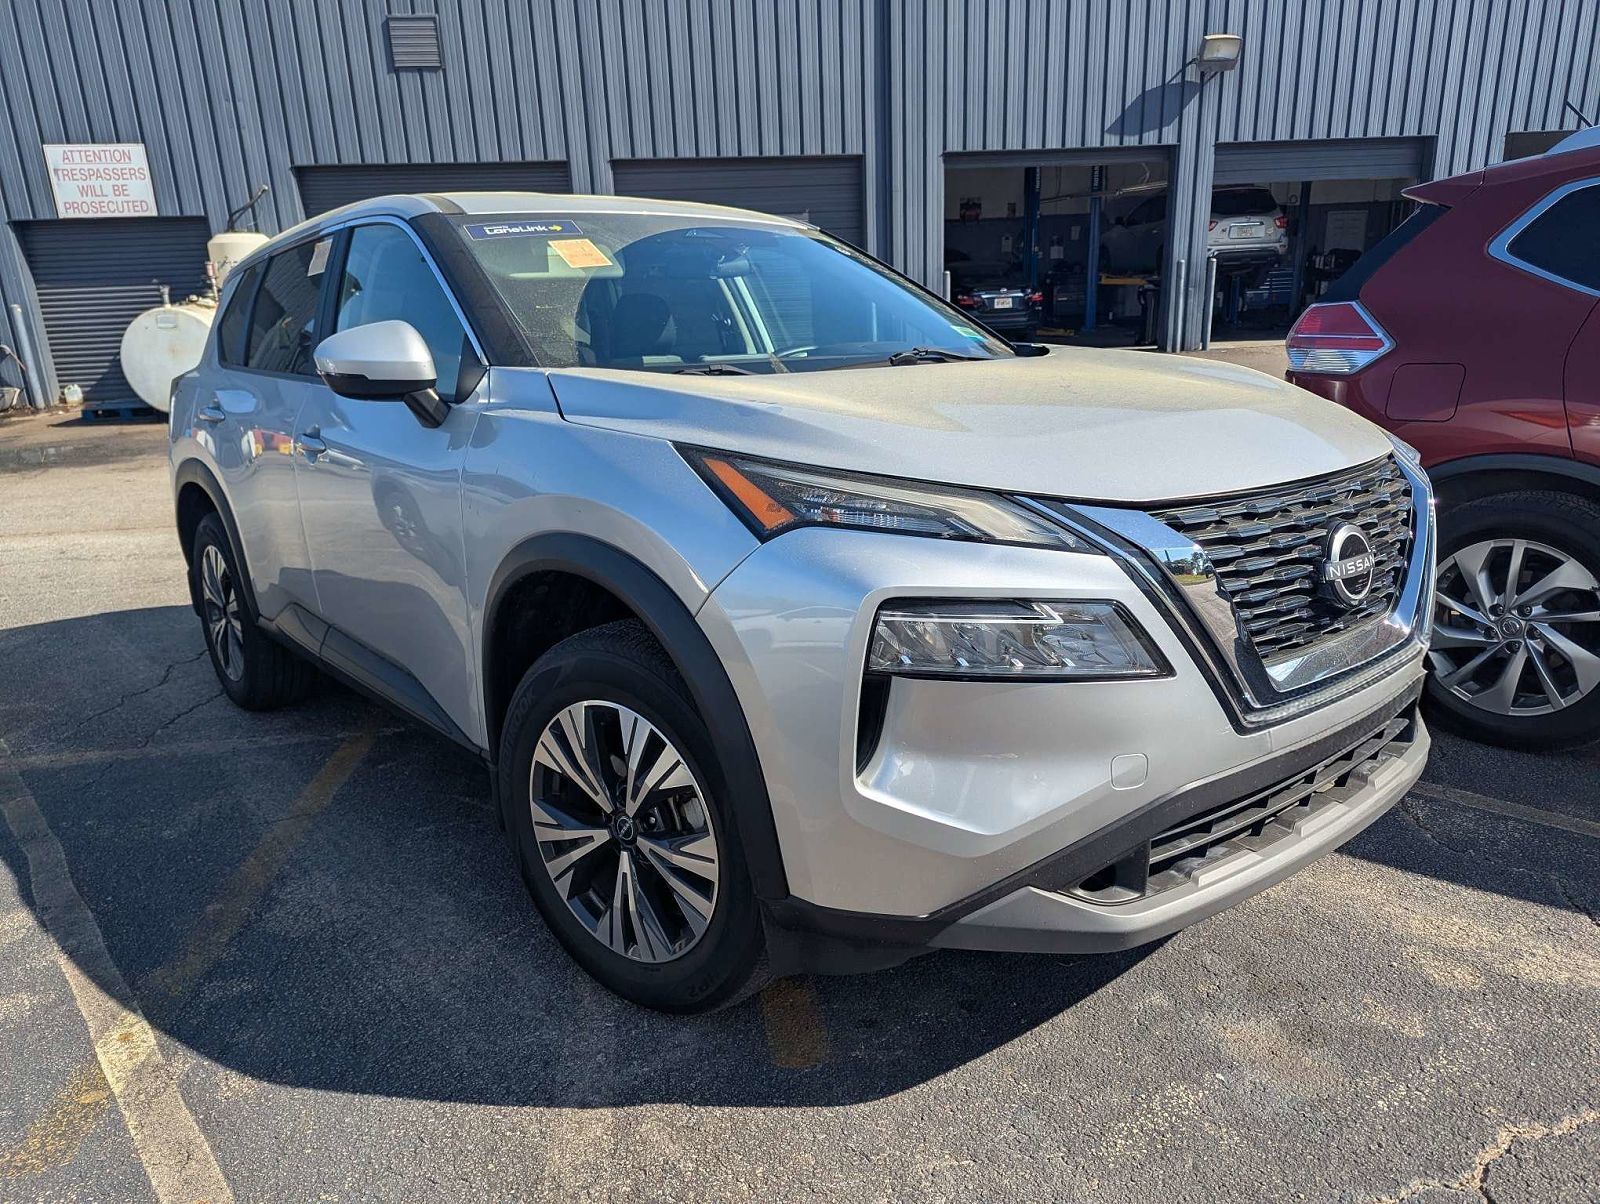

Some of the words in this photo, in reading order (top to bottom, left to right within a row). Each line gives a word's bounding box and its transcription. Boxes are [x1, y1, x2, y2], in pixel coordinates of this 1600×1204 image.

[62, 149, 132, 163] ATTENTION
[54, 167, 147, 182] TRESPASSERS
[77, 185, 108, 197] WILL
[112, 185, 130, 197] BE
[64, 201, 149, 214] PROSECUTED
[1329, 554, 1375, 578] NISSAN
